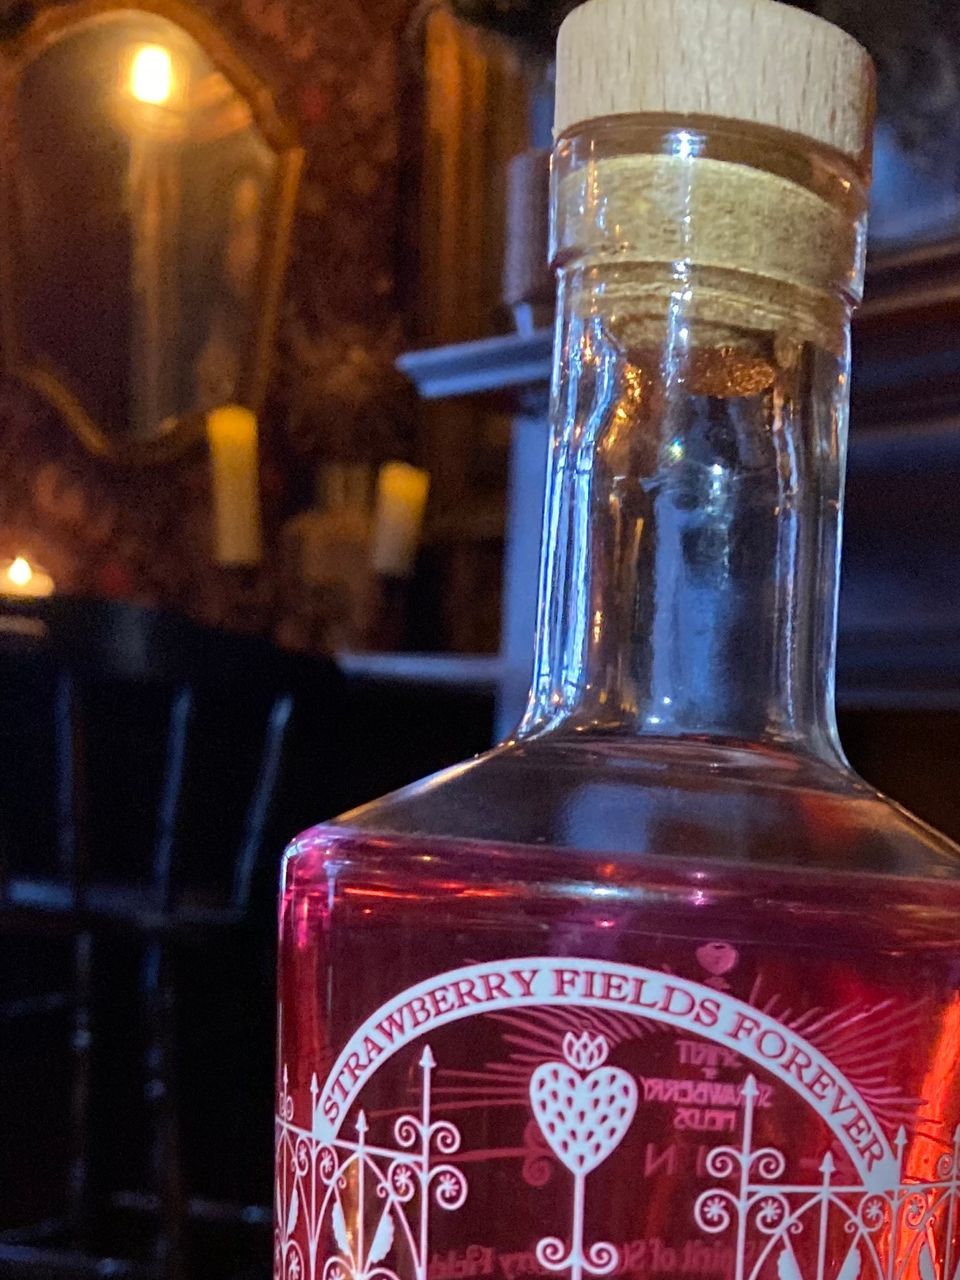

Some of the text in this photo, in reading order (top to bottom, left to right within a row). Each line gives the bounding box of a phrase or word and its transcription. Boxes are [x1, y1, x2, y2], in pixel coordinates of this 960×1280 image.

[323, 968, 885, 1173] STRAWBERRY FIELDS FOREVER
